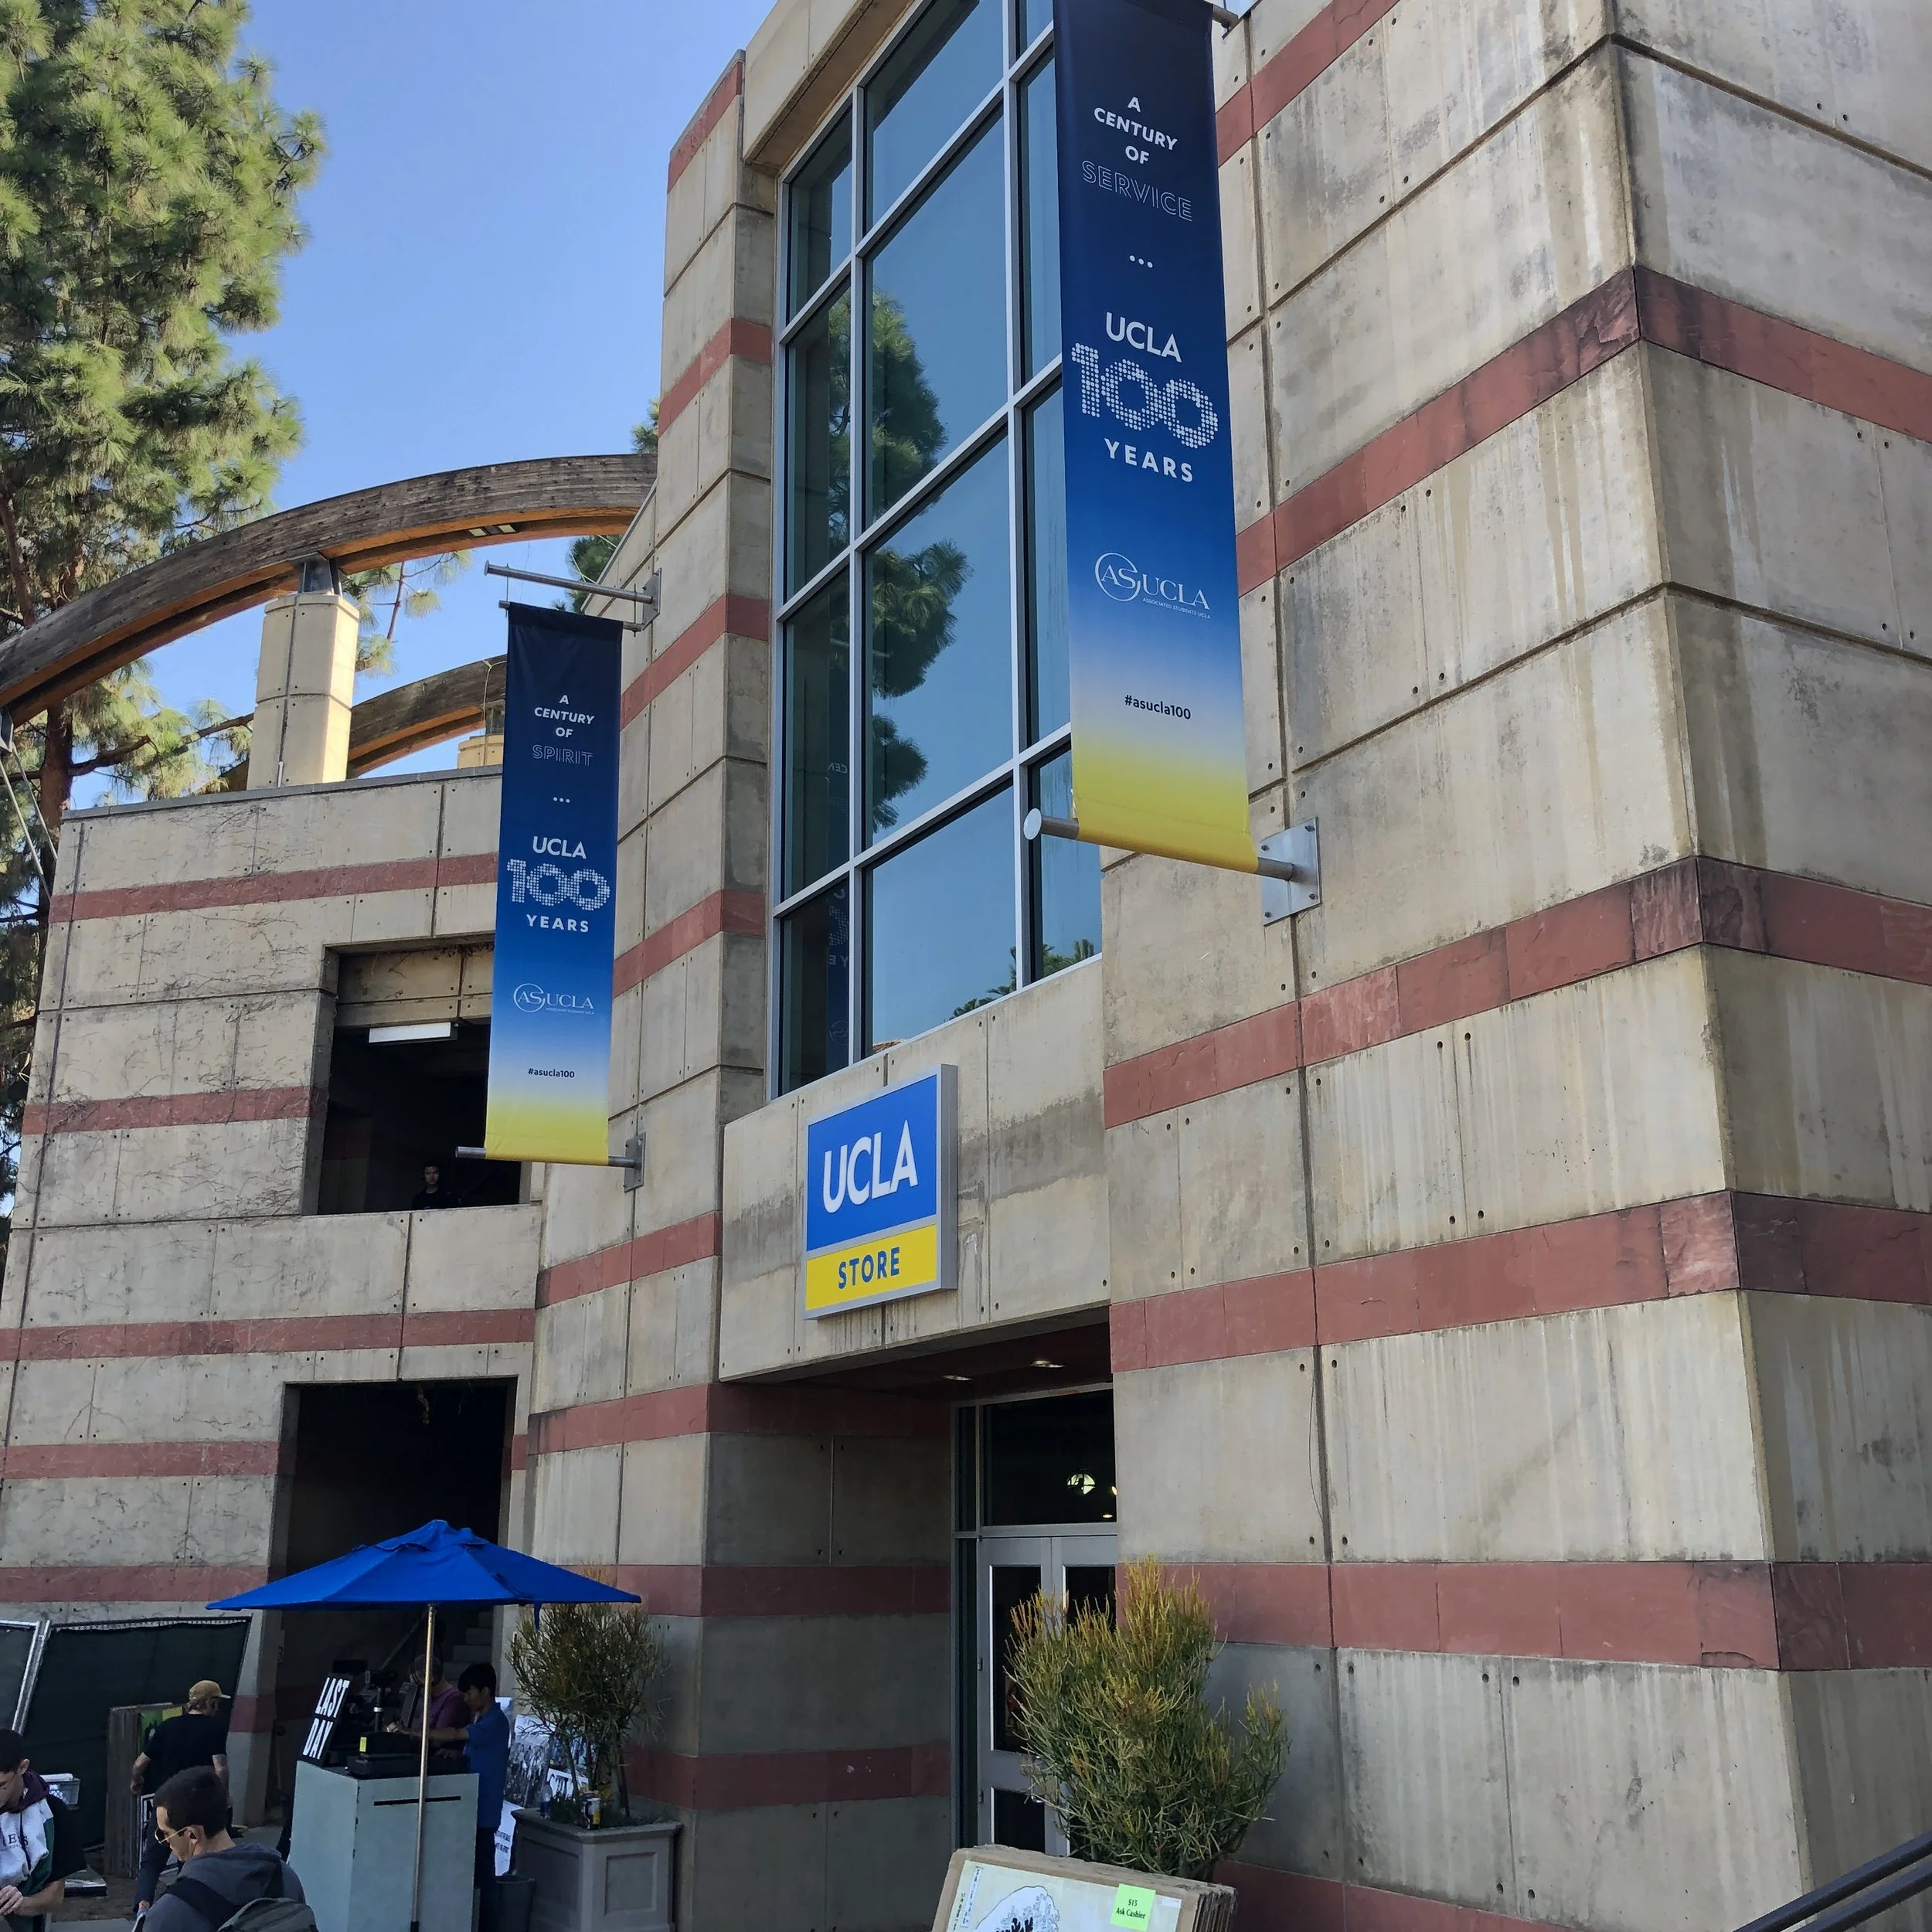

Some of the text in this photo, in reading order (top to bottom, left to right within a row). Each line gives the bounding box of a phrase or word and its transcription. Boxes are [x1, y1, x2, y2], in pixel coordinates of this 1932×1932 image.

[1128, 97, 1141, 113] A
[1094, 107, 1178, 150] CENTURY
[1125, 145, 1149, 164] OF
[1082, 160, 1192, 221] SERVICE
[1106, 311, 1182, 363] UCLA
[1071, 342, 1218, 449] 100
[1104, 437, 1193, 482] YEARS
[559, 695, 570, 705] A
[1124, 694, 1191, 719] #asucla100
[534, 707, 595, 725] CENTURY
[555, 727, 573, 738] OF
[532, 744, 594, 766] SPIRIT
[532, 835, 587, 859] UCLA
[507, 859, 610, 911] 100
[526, 914, 589, 933] YEARS
[528, 1067, 575, 1078] #asucla100
[823, 1119, 919, 1213] UCLA
[838, 1247, 900, 1289] STORE
[315, 1677, 350, 1718] LAST
[303, 1718, 333, 1760] DAY
[1126, 1909, 1145, 1919] Cashier
